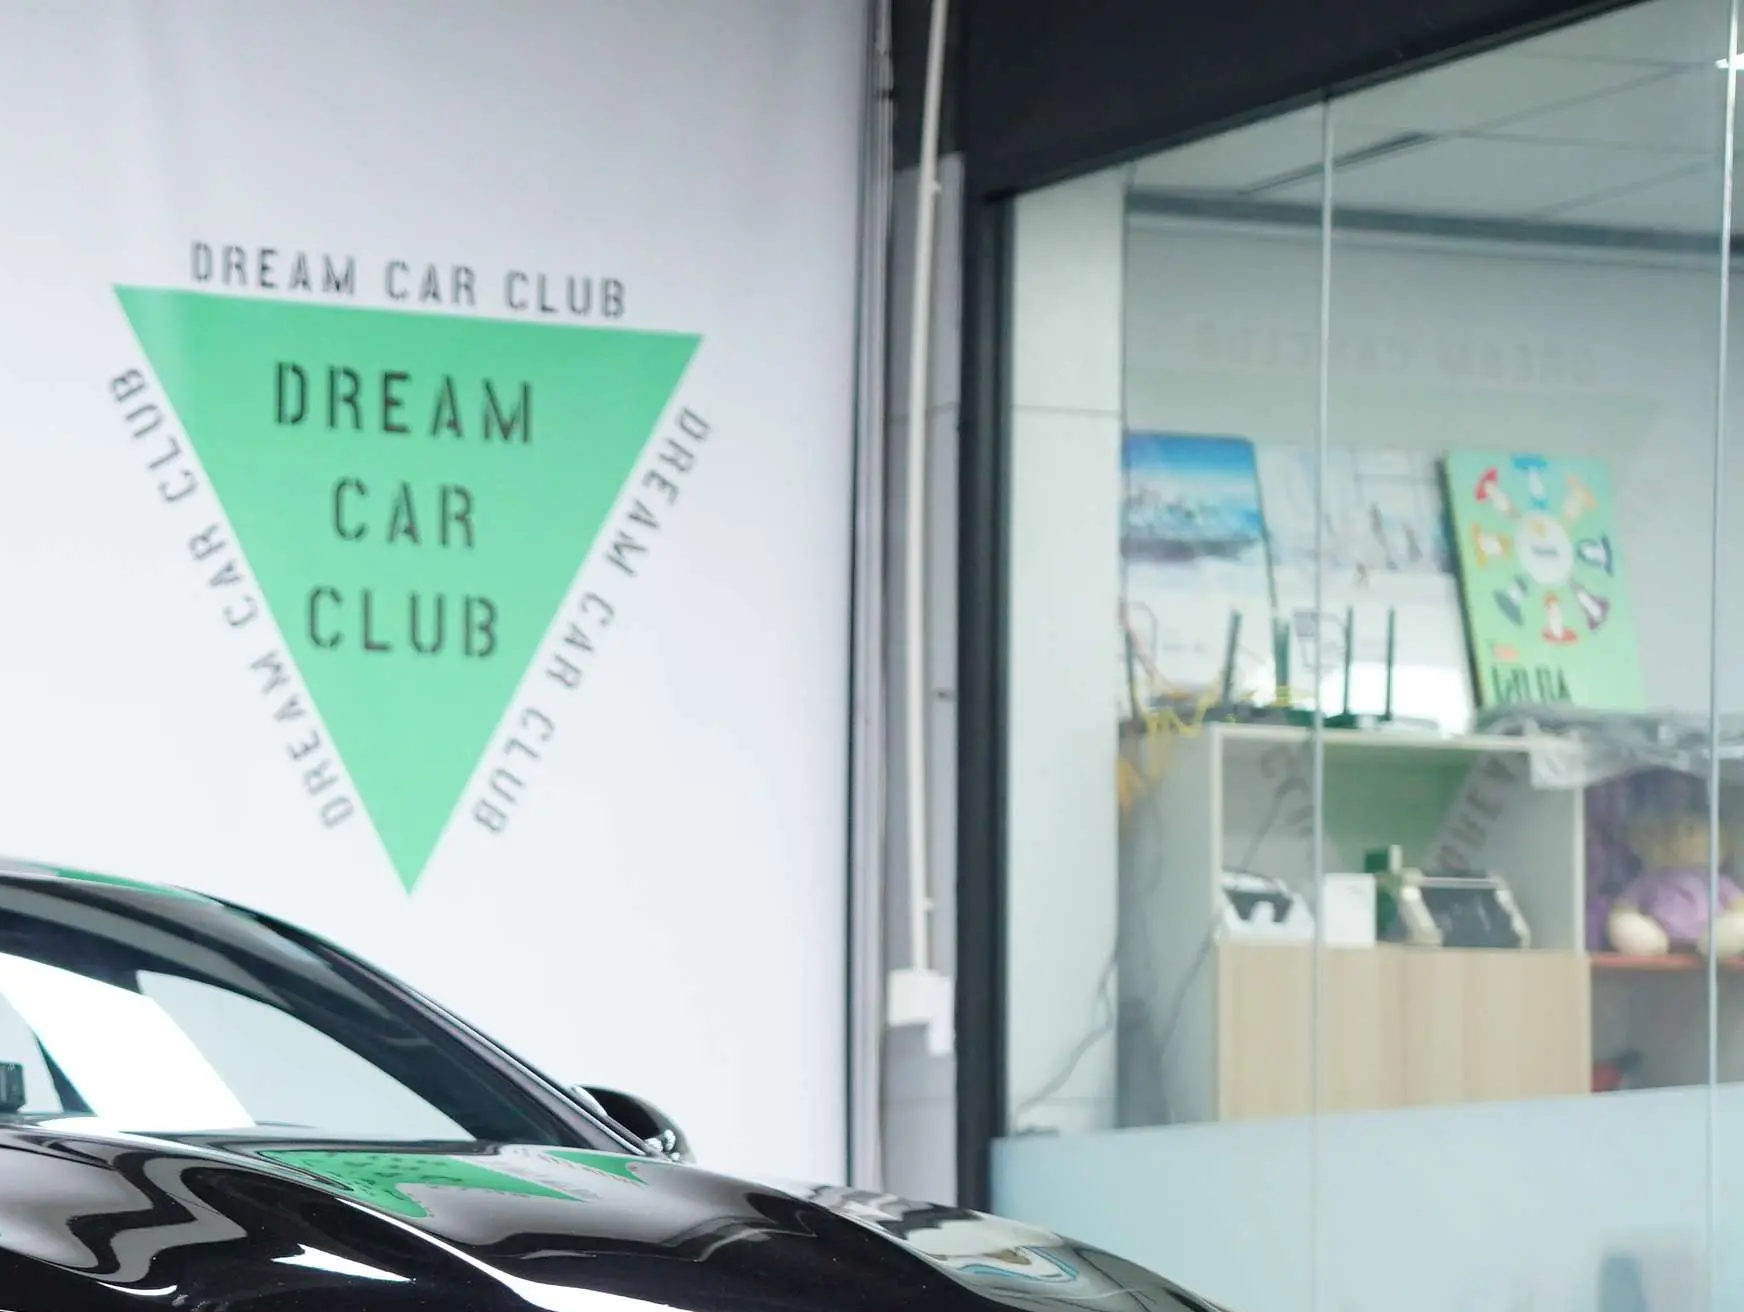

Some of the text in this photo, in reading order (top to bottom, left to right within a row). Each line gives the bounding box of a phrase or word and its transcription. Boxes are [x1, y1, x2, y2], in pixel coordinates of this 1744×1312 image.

[191, 241, 626, 319] DREAM CAR CLUB
[273, 360, 533, 444] DREAM
[331, 476, 476, 548] CAR
[109, 366, 356, 829] DREAM CAR CLUB
[305, 584, 499, 658] CLUB
[471, 405, 712, 835] DREAM CAR CLUB
